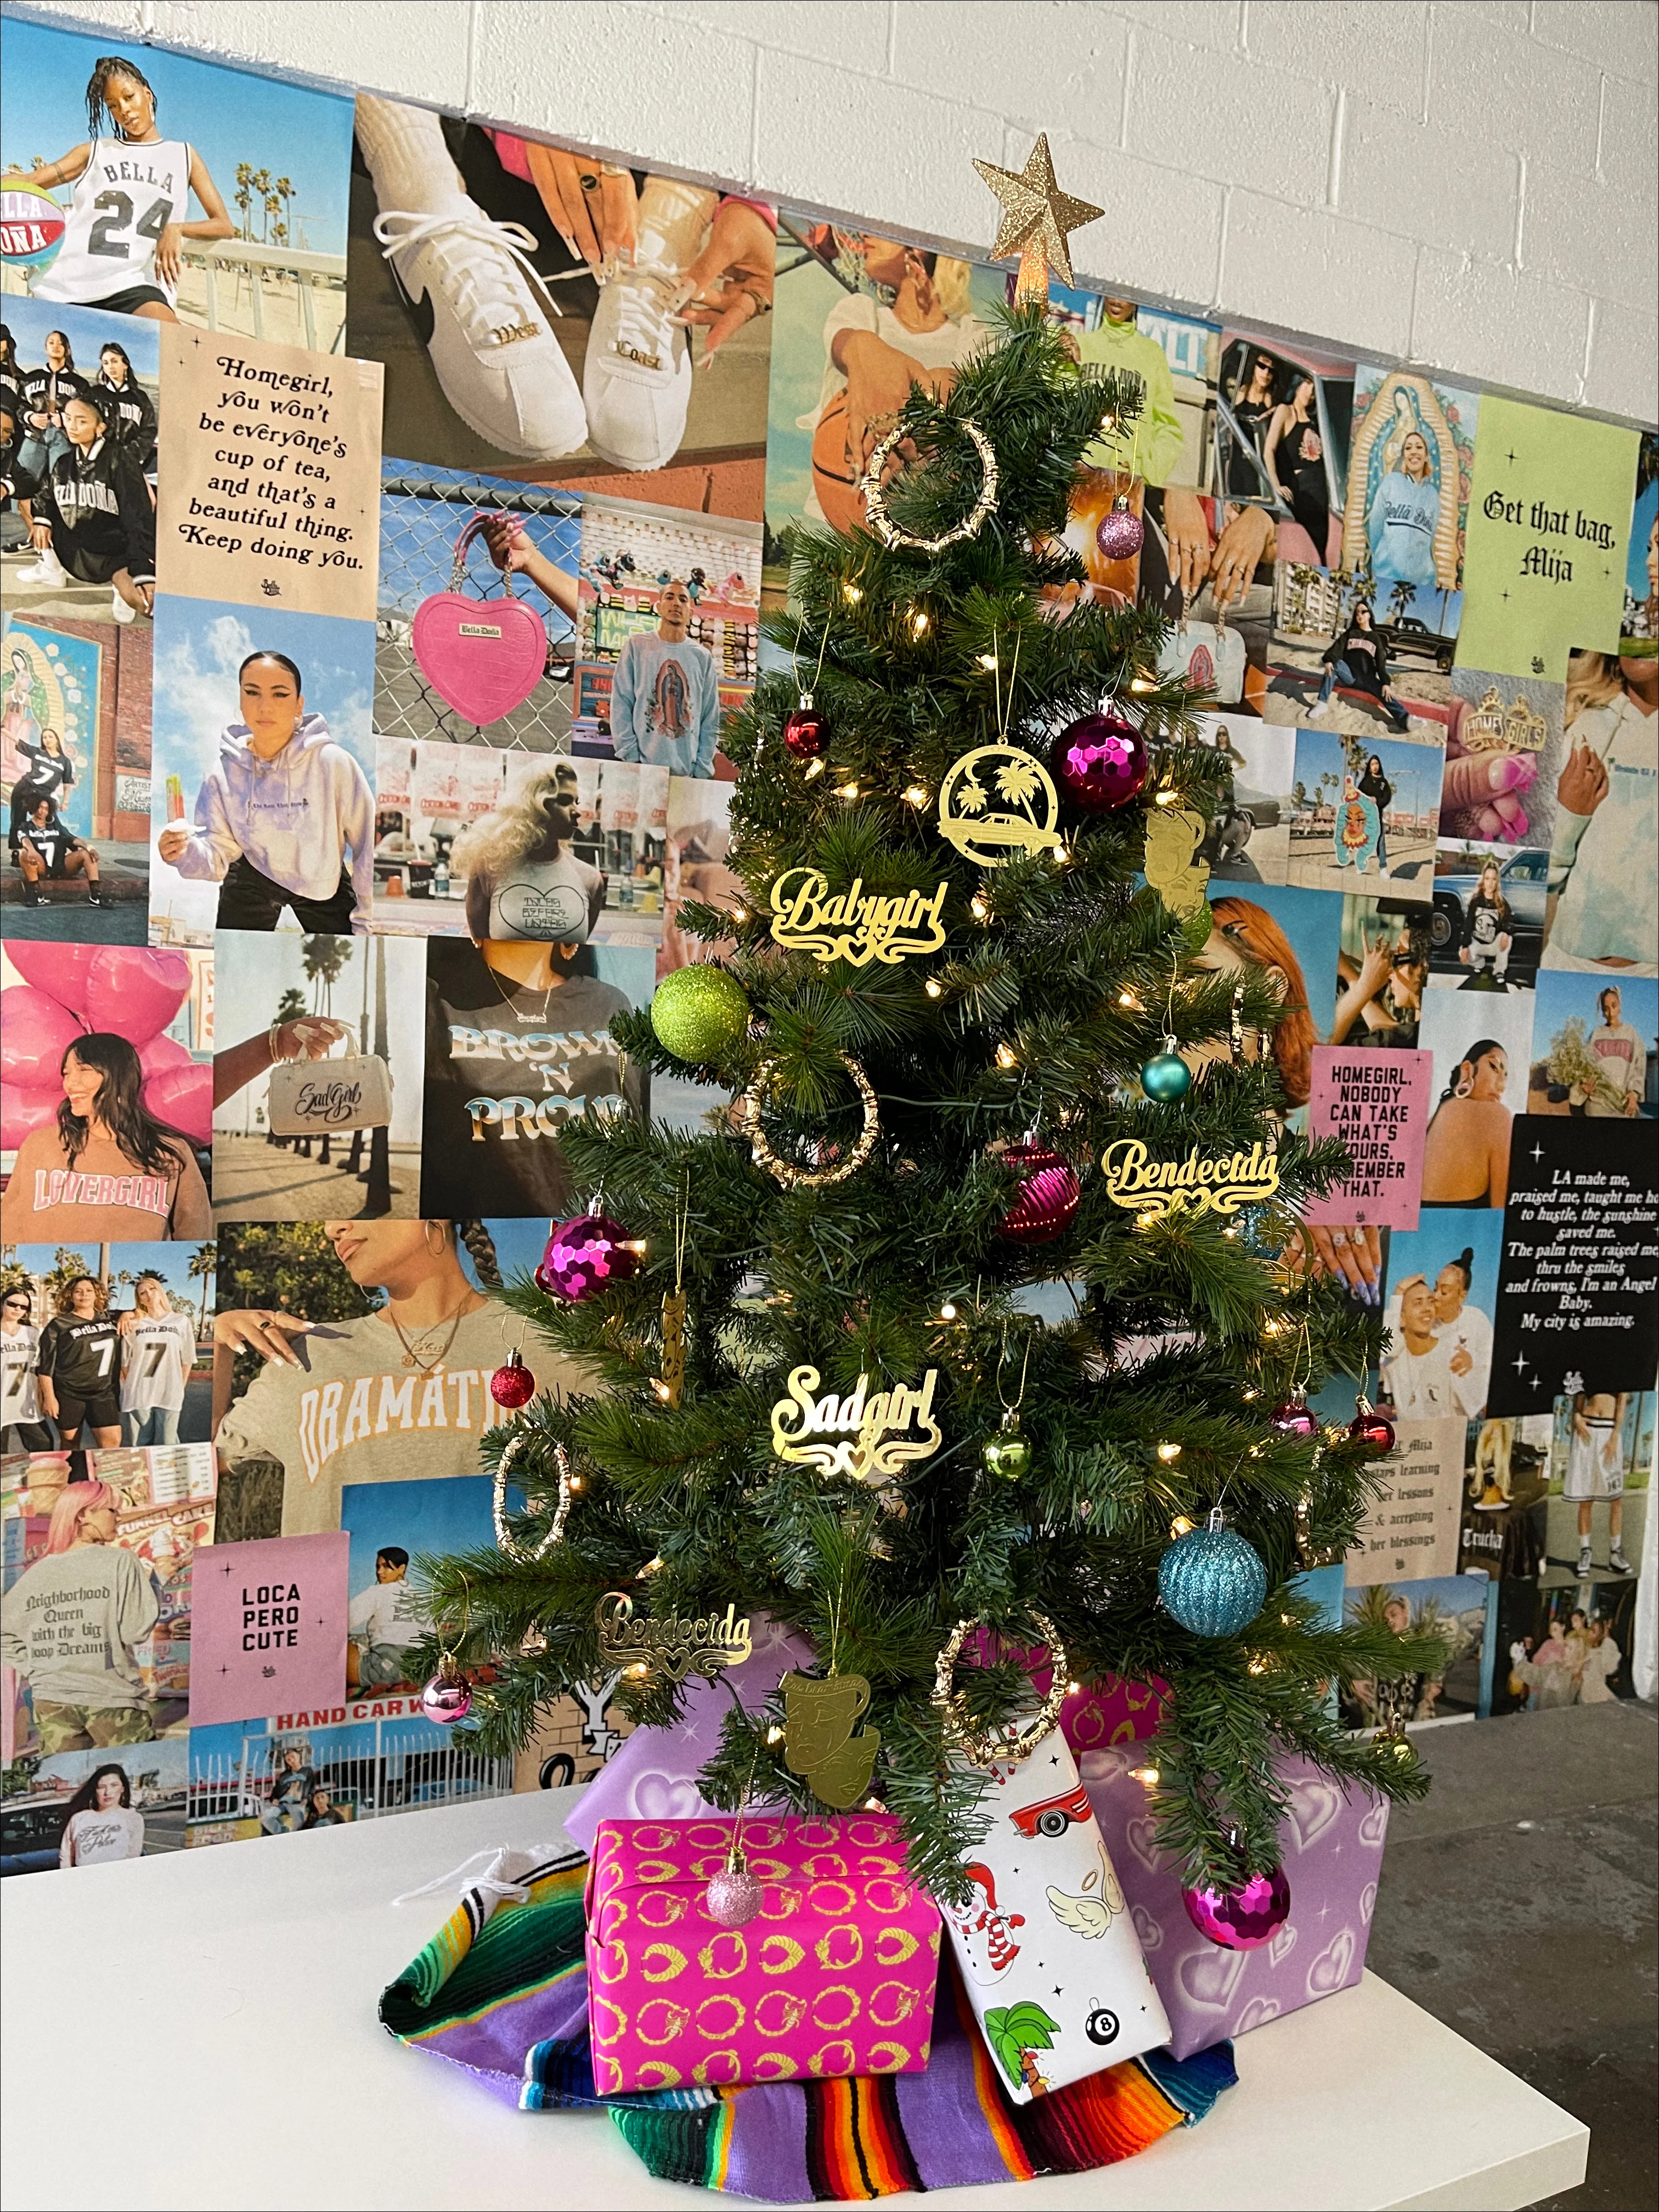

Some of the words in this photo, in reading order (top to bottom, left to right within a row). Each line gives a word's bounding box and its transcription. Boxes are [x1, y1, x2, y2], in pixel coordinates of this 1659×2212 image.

[104, 161, 173, 193] BELLA
[0, 192, 43, 218] LLA
[88, 190, 173, 259] 24
[216, 357, 333, 398] Homegirl,
[217, 391, 259, 410] you
[270, 400, 330, 423] won't
[199, 413, 225, 432] be
[233, 424, 348, 458] everyone's
[215, 450, 253, 470] cup
[263, 455, 289, 471] of
[295, 460, 330, 483] tea,
[207, 477, 250, 498] and
[258, 482, 317, 509] that's
[325, 497, 336, 510] a
[189, 498, 287, 529] beautiful
[295, 516, 353, 543] thing.
[1483, 490, 1523, 525] Get
[1531, 501, 1570, 535] that
[1575, 509, 1615, 549] bag,
[178, 524, 242, 554] Keep
[250, 538, 313, 565] doing
[319, 551, 363, 569] you.
[1519, 546, 1572, 585] Mija
[32, 766, 54, 785] 7
[37, 842, 55, 867] 7
[770, 867, 948, 941] Babygirl
[448, 1025, 620, 1062] BROWN
[1340, 1086, 1401, 1103] NOBODY
[1330, 1104, 1361, 1121] CAN
[1369, 1105, 1408, 1122] TAKE
[1339, 1124, 1397, 1141] WHAT'S
[1347, 1143, 1393, 1160] OURS.
[1101, 1139, 1278, 1191] Bendecida
[1351, 1161, 1405, 1178] EMBER
[1342, 1181, 1384, 1197] THAT.
[1551, 1169, 1571, 1184] LA
[1574, 1171, 1606, 1185] made
[1609, 1175, 1630, 1188] me,
[33, 1169, 170, 1219] LOVERGIRL
[1508, 1188, 1558, 1205] praised
[1559, 1193, 1579, 1205] me,
[1584, 1189, 1622, 1206] taught
[1624, 1193, 1643, 1204] me
[1645, 1189, 1659, 1204] ho
[1520, 1209, 1534, 1220] to
[1537, 1206, 1577, 1223] hustle,
[1581, 1206, 1601, 1221] the
[1602, 1206, 1657, 1224] sunshine
[1555, 1224, 1595, 1241] saved
[1595, 1228, 1616, 1238] me.
[1508, 1242, 1533, 1257] The
[1534, 1242, 1566, 1259] palm
[1569, 1244, 1599, 1259] trees
[1601, 1242, 1640, 1259] raised
[1536, 1260, 1562, 1274] thru
[1564, 1260, 1584, 1273] the
[1585, 1259, 1626, 1276] smiles
[1505, 1278, 1530, 1293] and
[1531, 1278, 1577, 1294] frowns,
[1581, 1277, 1599, 1291] I'm
[1602, 1281, 1617, 1291] an
[1620, 1276, 1657, 1294] Angel
[1558, 1295, 1592, 1312] Baby.
[1520, 1313, 1541, 1331] My
[1544, 1313, 1566, 1331] city
[1568, 1313, 1581, 1330] is
[1583, 1312, 1634, 1329] amazing.
[90, 1338, 114, 1377] 7
[143, 1342, 167, 1378] 7
[7, 1362, 28, 1397] 7
[771, 1364, 937, 1442] Sadgirl
[299, 1364, 540, 1483] DRAMÁTI
[1401, 1464, 1440, 1476] learning
[1398, 1487, 1434, 1500] lessons
[1370, 1539, 1386, 1552] her
[1390, 1534, 1436, 1548] blessings
[25, 1586, 110, 1612] Neighborhood
[242, 1583, 301, 1606] LOCA
[44, 1609, 83, 1623] Queen
[244, 1606, 298, 1629] PERO
[595, 1592, 752, 1646] Bendecida
[59, 1626, 75, 1639] the
[83, 1622, 102, 1638] big
[242, 1629, 298, 1651] CUTE
[277, 1707, 346, 1730] HAND
[353, 1700, 403, 1719] CAR
[1101, 2017, 1112, 2032] 8
